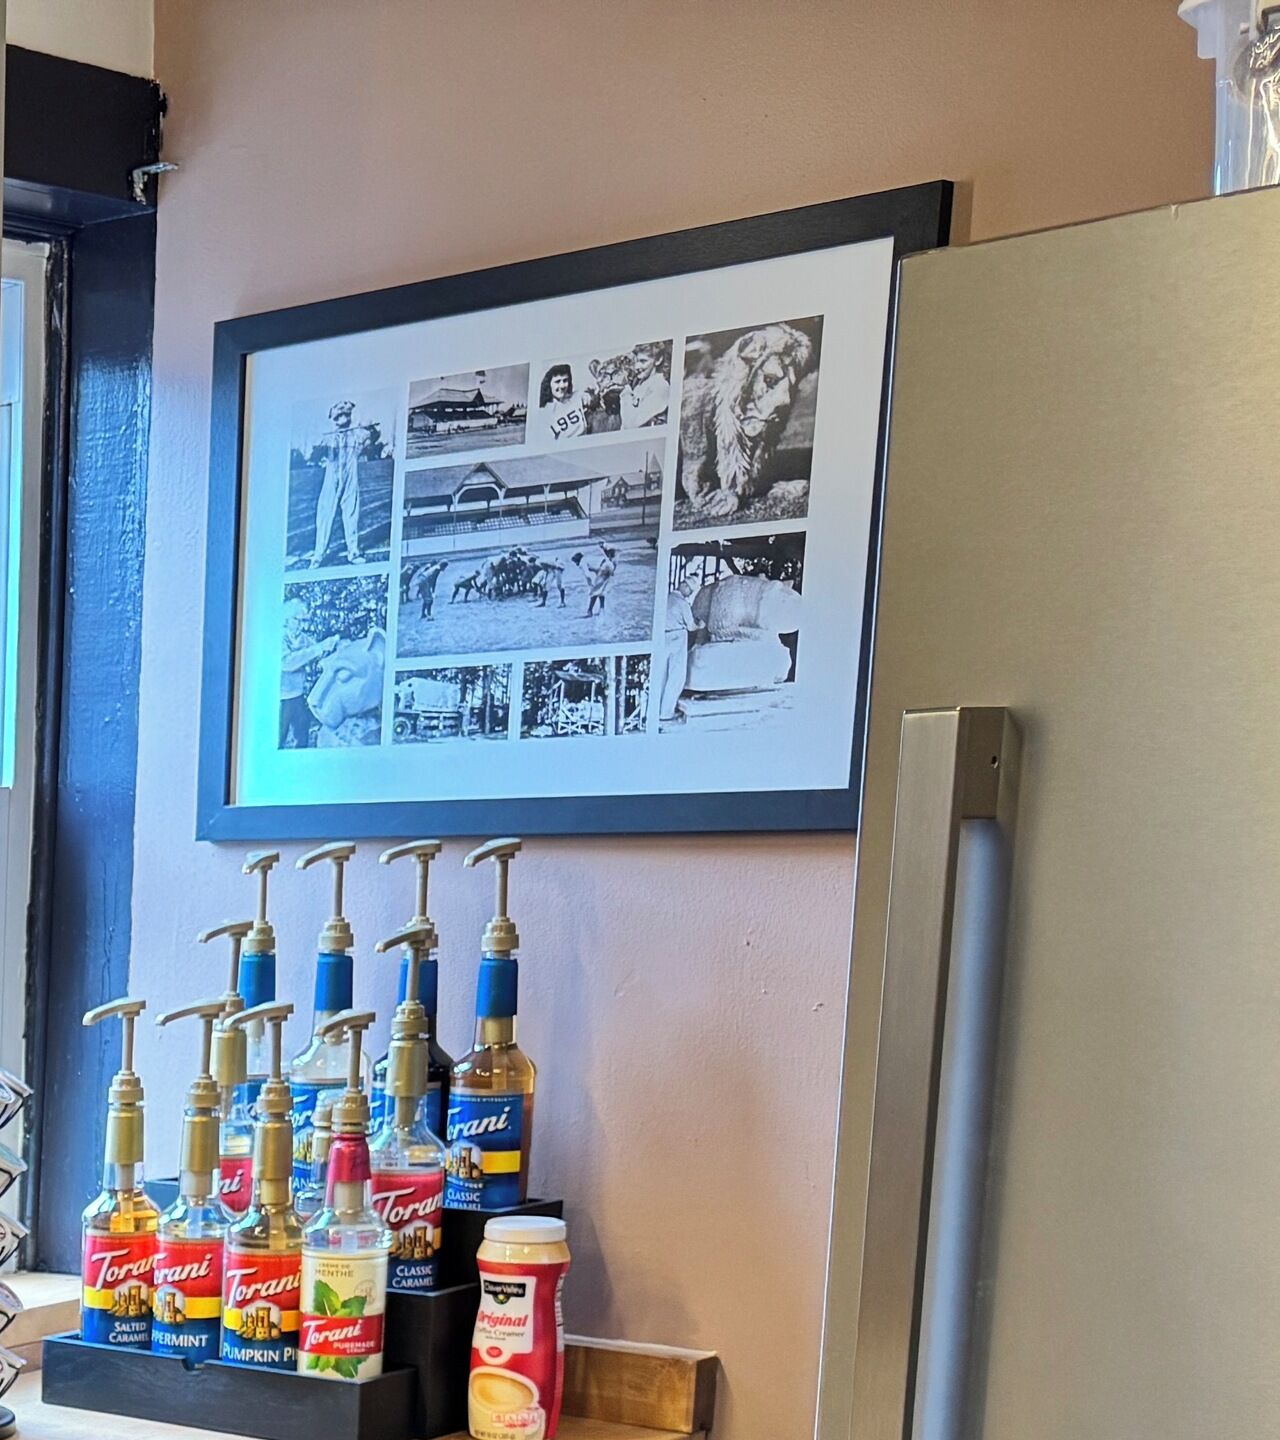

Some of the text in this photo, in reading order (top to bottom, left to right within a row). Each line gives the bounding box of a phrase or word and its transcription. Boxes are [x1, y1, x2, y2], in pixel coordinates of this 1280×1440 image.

[372, 1187, 443, 1223] Toran
[91, 1249, 155, 1291] Toran
[315, 1269, 354, 1278] MENTHE
[396, 1264, 433, 1277] CLASSIC
[392, 1277, 433, 1288] CARAMEL
[114, 1321, 146, 1332] SALTED
[108, 1332, 150, 1344] CARAMEL
[303, 1319, 363, 1351] Torani
[222, 1342, 298, 1362] PUMPKIN PI
